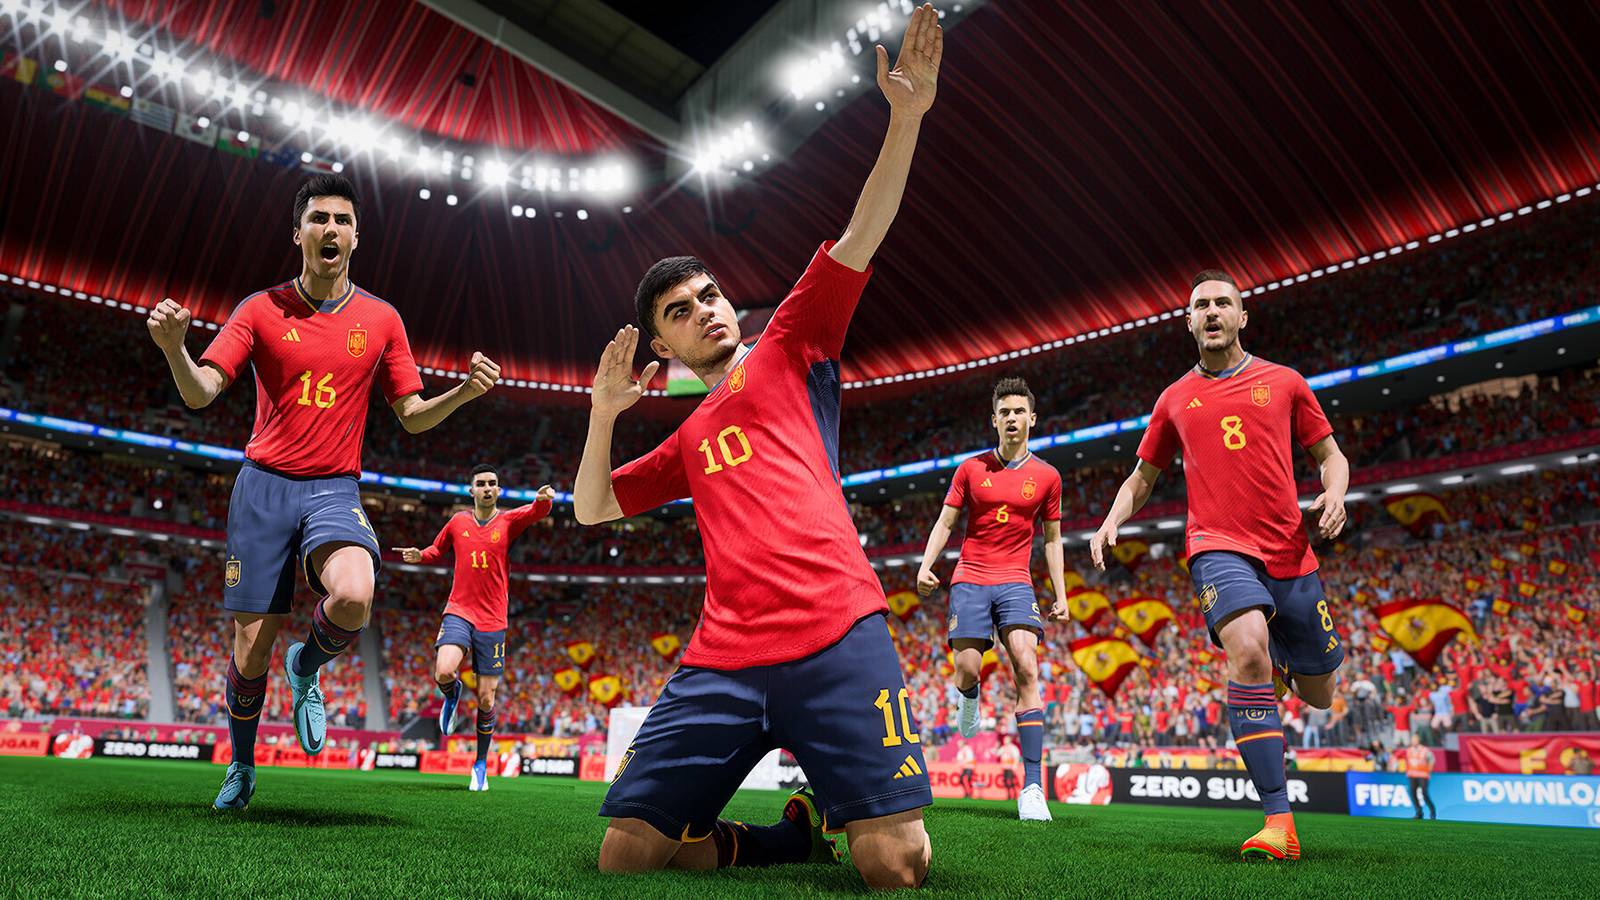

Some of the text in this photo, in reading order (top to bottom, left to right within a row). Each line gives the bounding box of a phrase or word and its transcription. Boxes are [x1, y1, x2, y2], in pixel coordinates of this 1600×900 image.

[297, 370, 336, 409] 16
[1220, 415, 1247, 450] 8
[697, 424, 753, 475] 10
[996, 504, 1009, 523] 6
[471, 550, 489, 568] 11
[1316, 599, 1333, 632] 8
[103, 741, 200, 759] ZERO SUGAR
[928, 771, 962, 787] ERO
[1129, 774, 1201, 799] ZERO
[1462, 779, 1600, 807] DOWNLO
